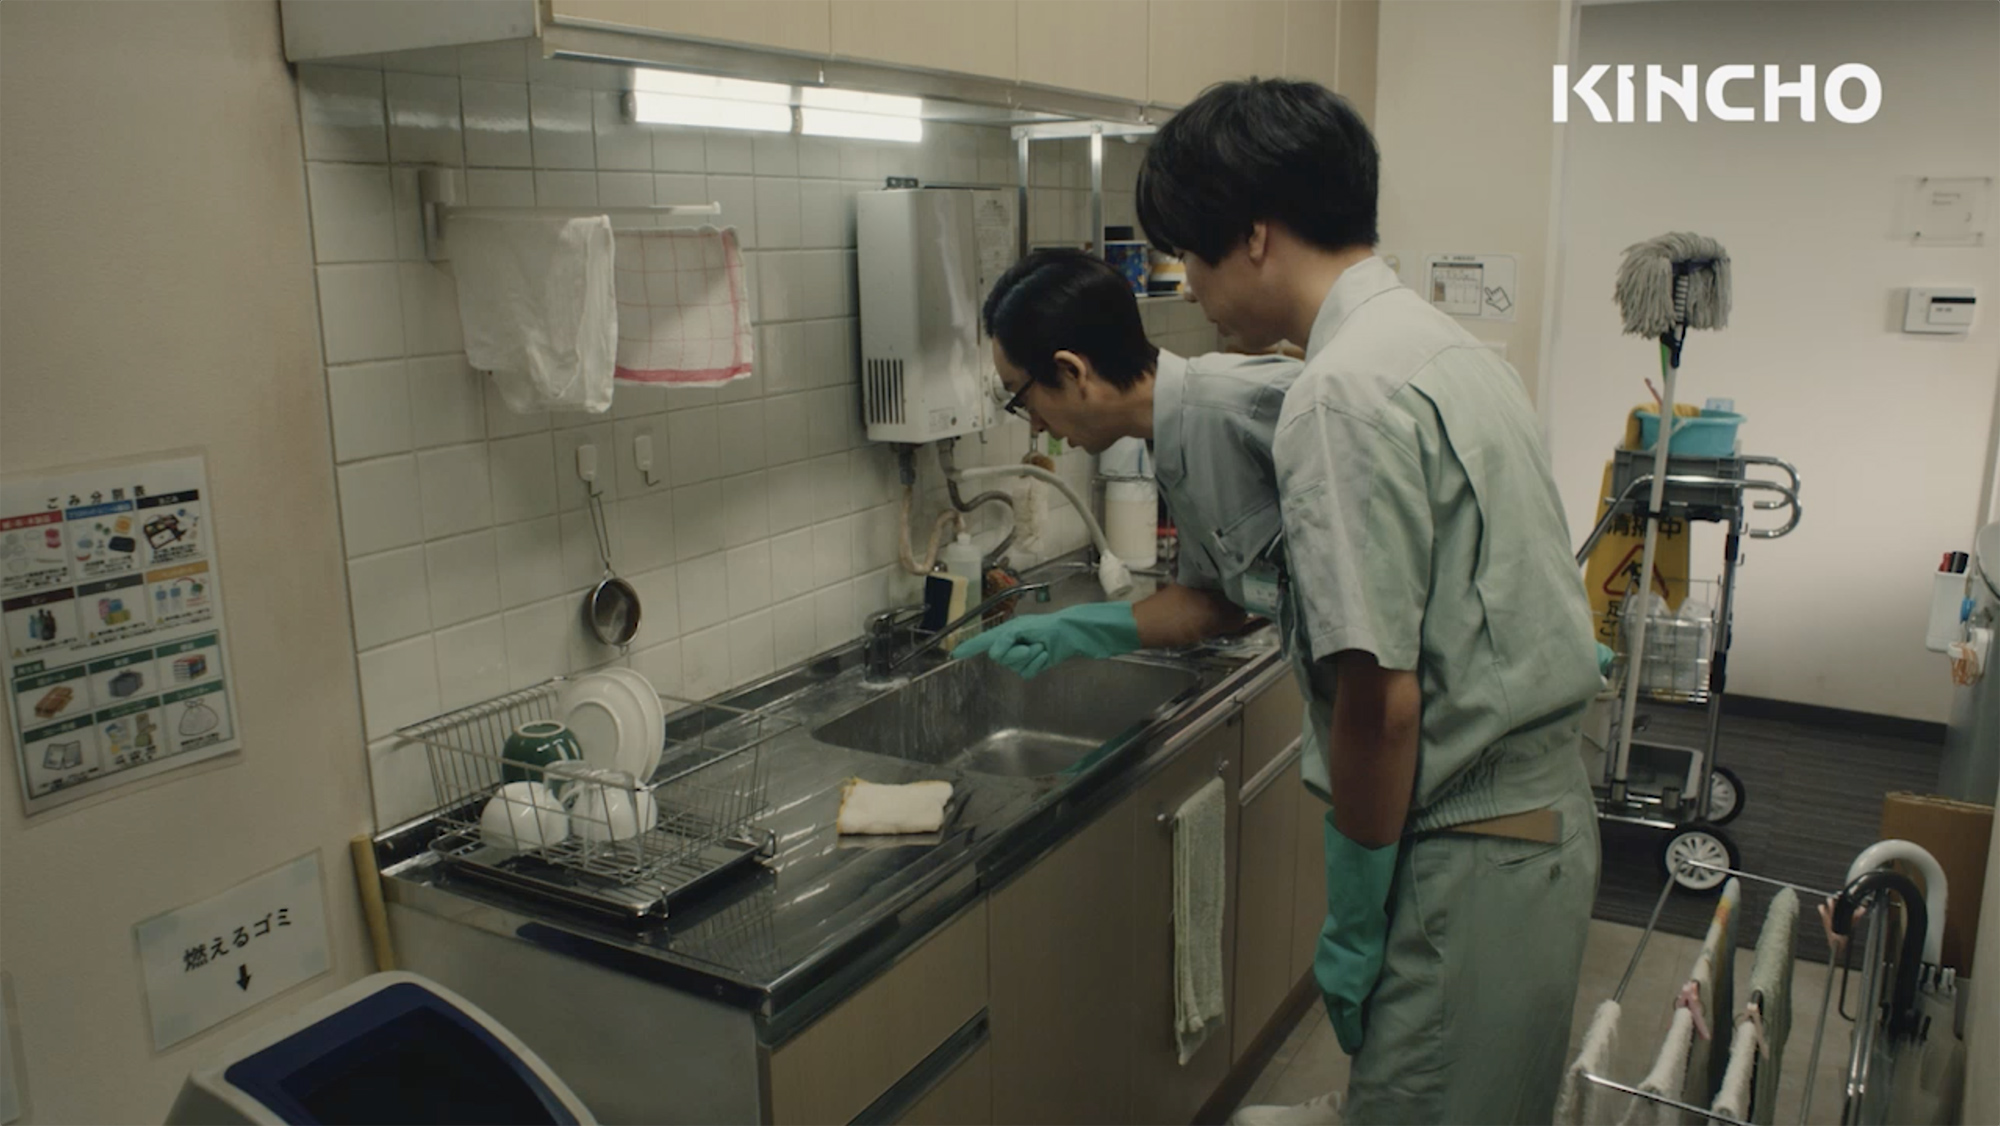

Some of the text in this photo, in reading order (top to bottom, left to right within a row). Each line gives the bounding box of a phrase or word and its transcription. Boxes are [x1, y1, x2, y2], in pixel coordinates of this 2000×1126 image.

[47, 485, 146, 510] ごみ分別表
[183, 908, 292, 972] 燃えるゴミ
